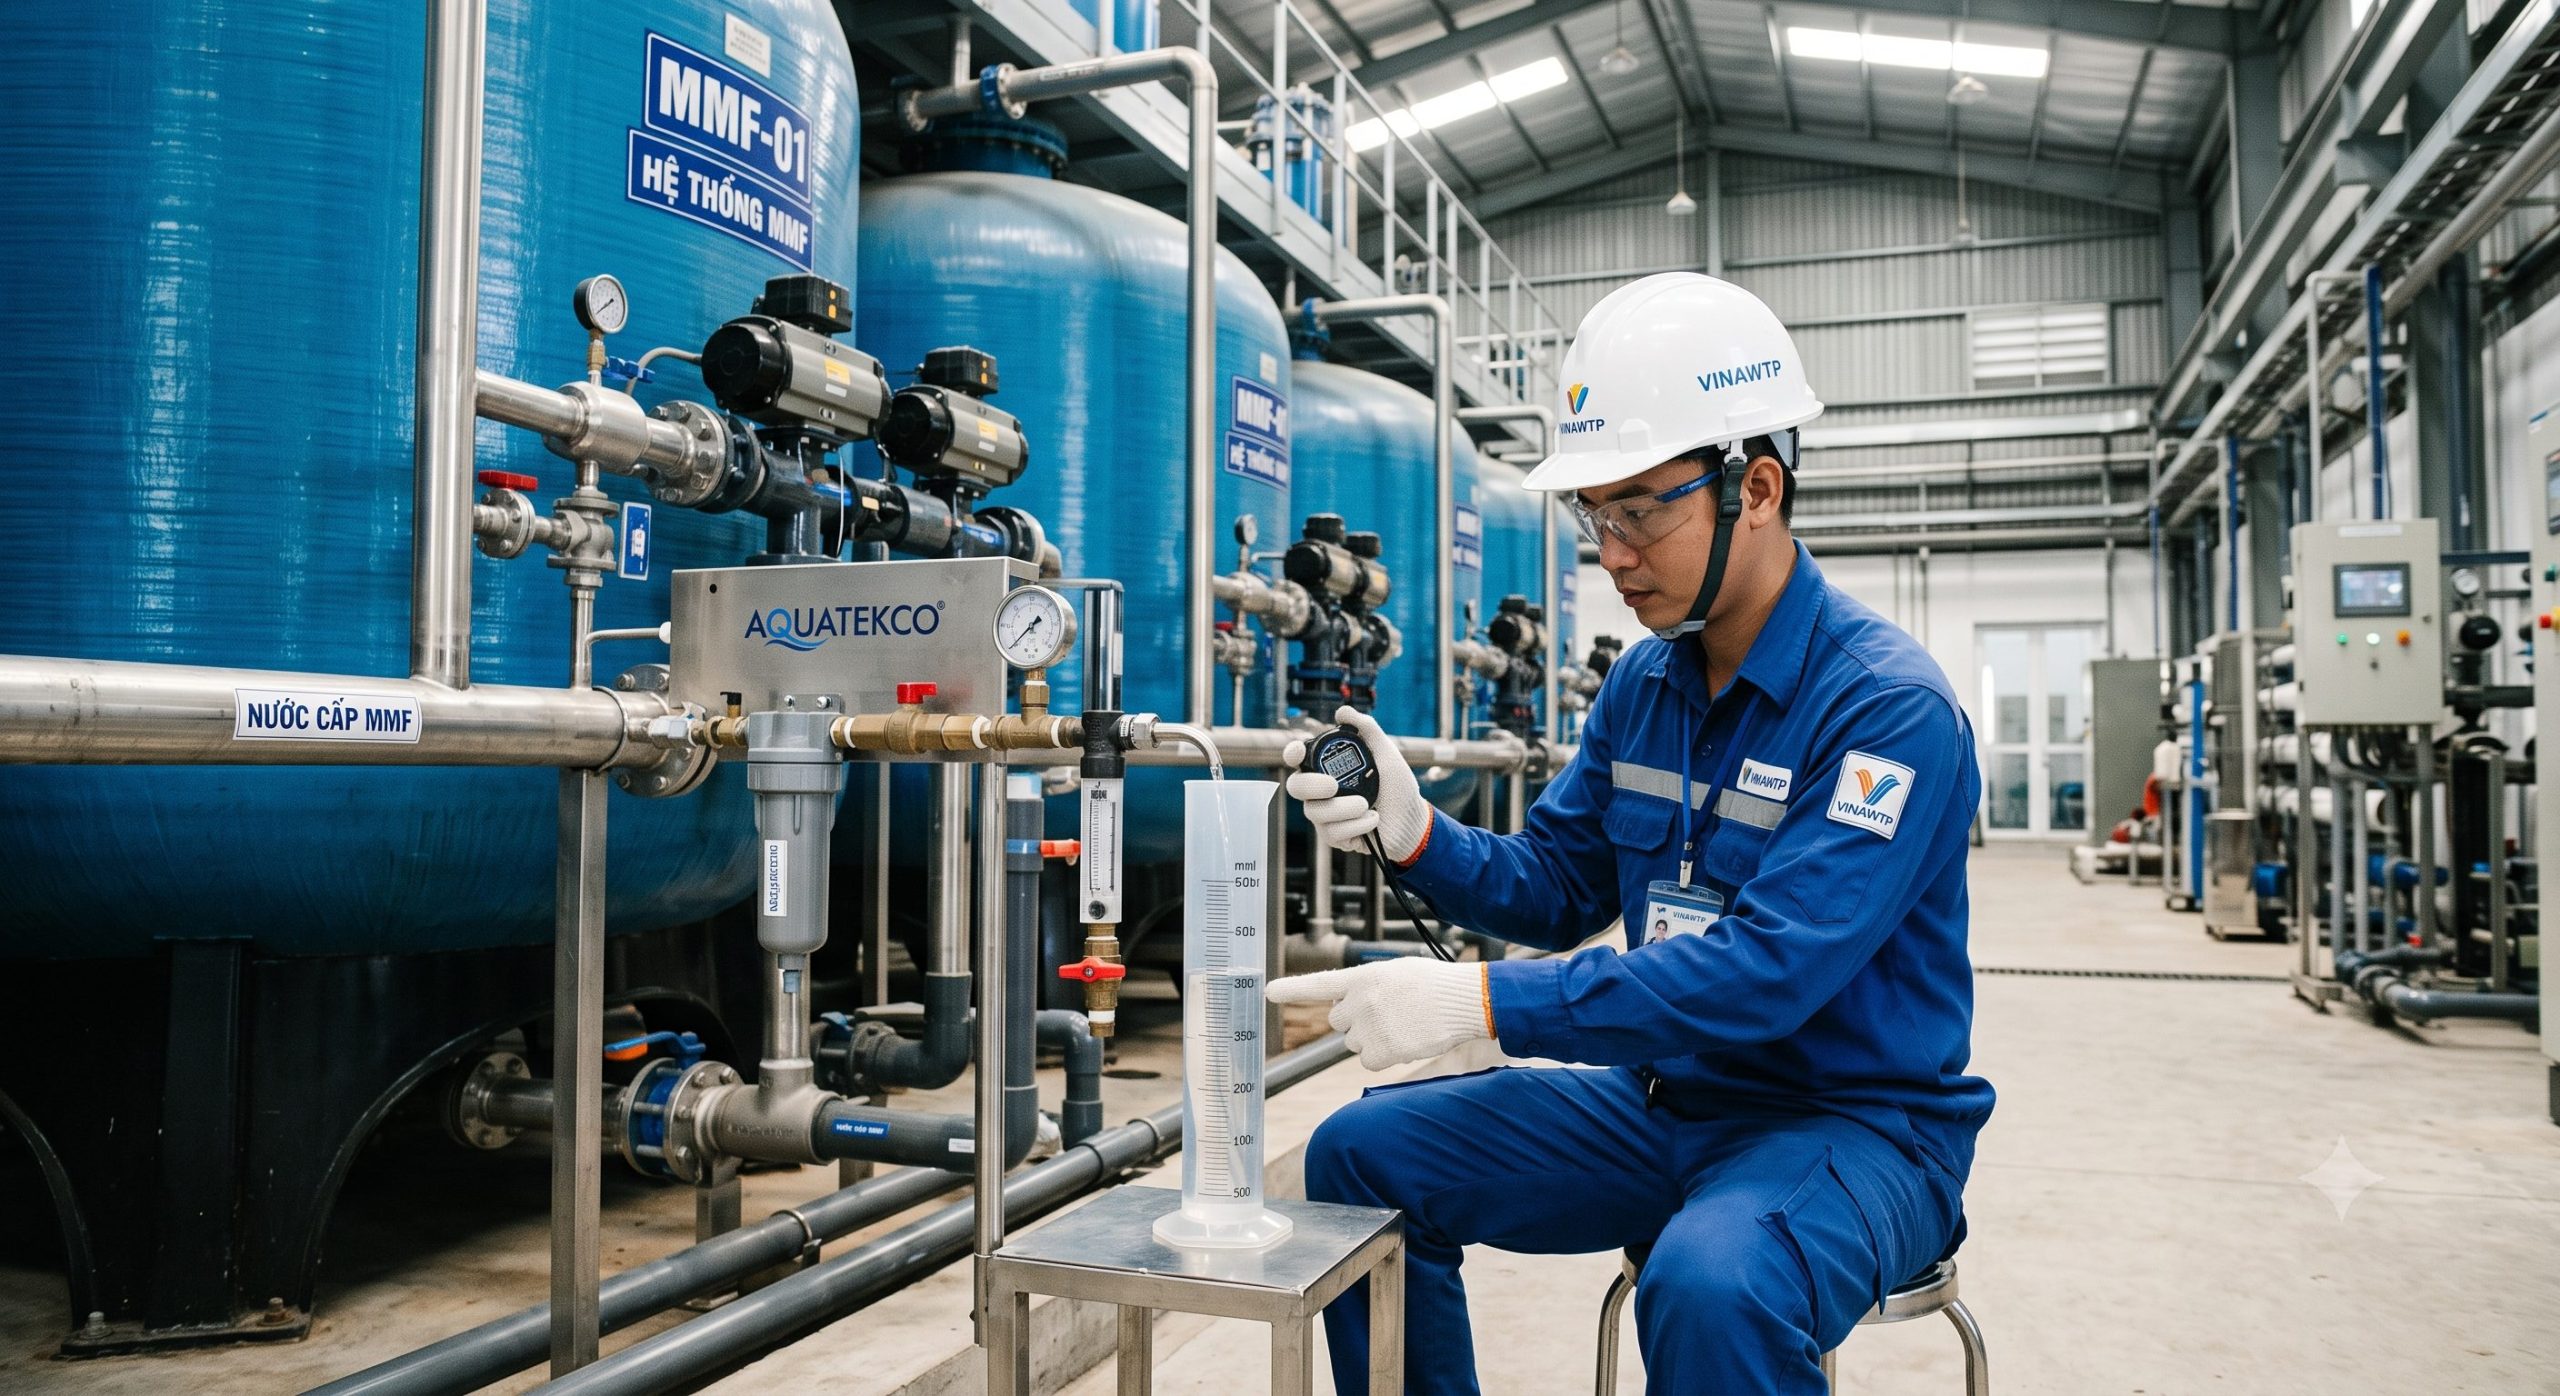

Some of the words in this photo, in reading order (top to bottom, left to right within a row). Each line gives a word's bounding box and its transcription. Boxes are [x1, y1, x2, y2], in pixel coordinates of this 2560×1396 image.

[659, 56, 806, 184] MMF-01
[642, 154, 680, 206] HỆ
[687, 173, 764, 234] THỐNG
[768, 205, 809, 255] MMF
[1697, 359, 1781, 392] VINAWTP
[247, 697, 309, 730] NƯỚC
[316, 697, 358, 731] CẤP
[365, 708, 412, 732] MMF
[1837, 800, 1894, 826] VINAWTP
[1673, 911, 1707, 923] VINAWTP
[1233, 1187, 1251, 1198] 500
